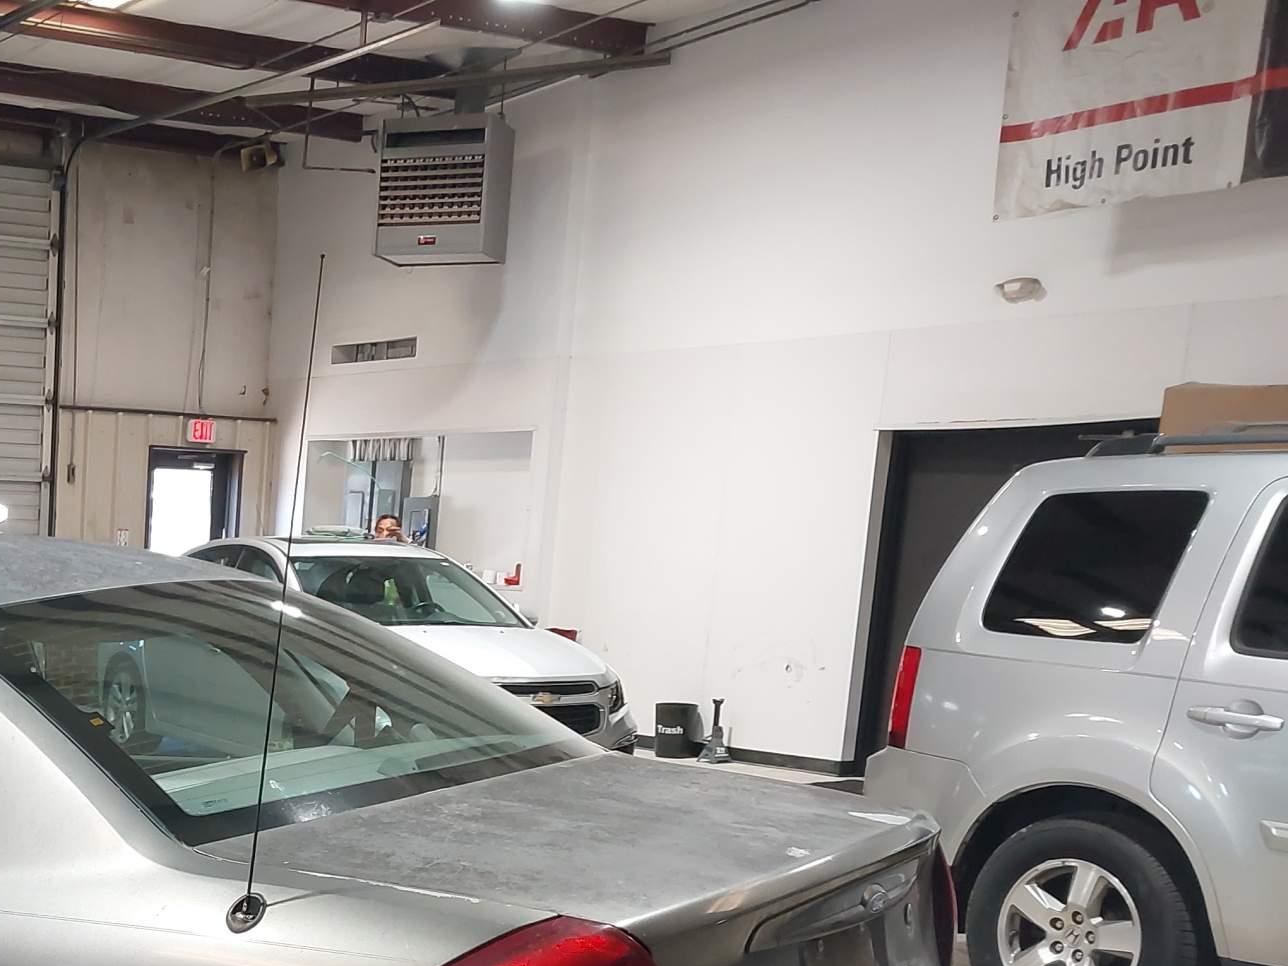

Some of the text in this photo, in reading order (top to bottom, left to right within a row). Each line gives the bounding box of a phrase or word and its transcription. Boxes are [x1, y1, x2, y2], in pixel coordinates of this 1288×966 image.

[1044, 136, 1196, 190] High Point
[656, 724, 684, 735] Trash
